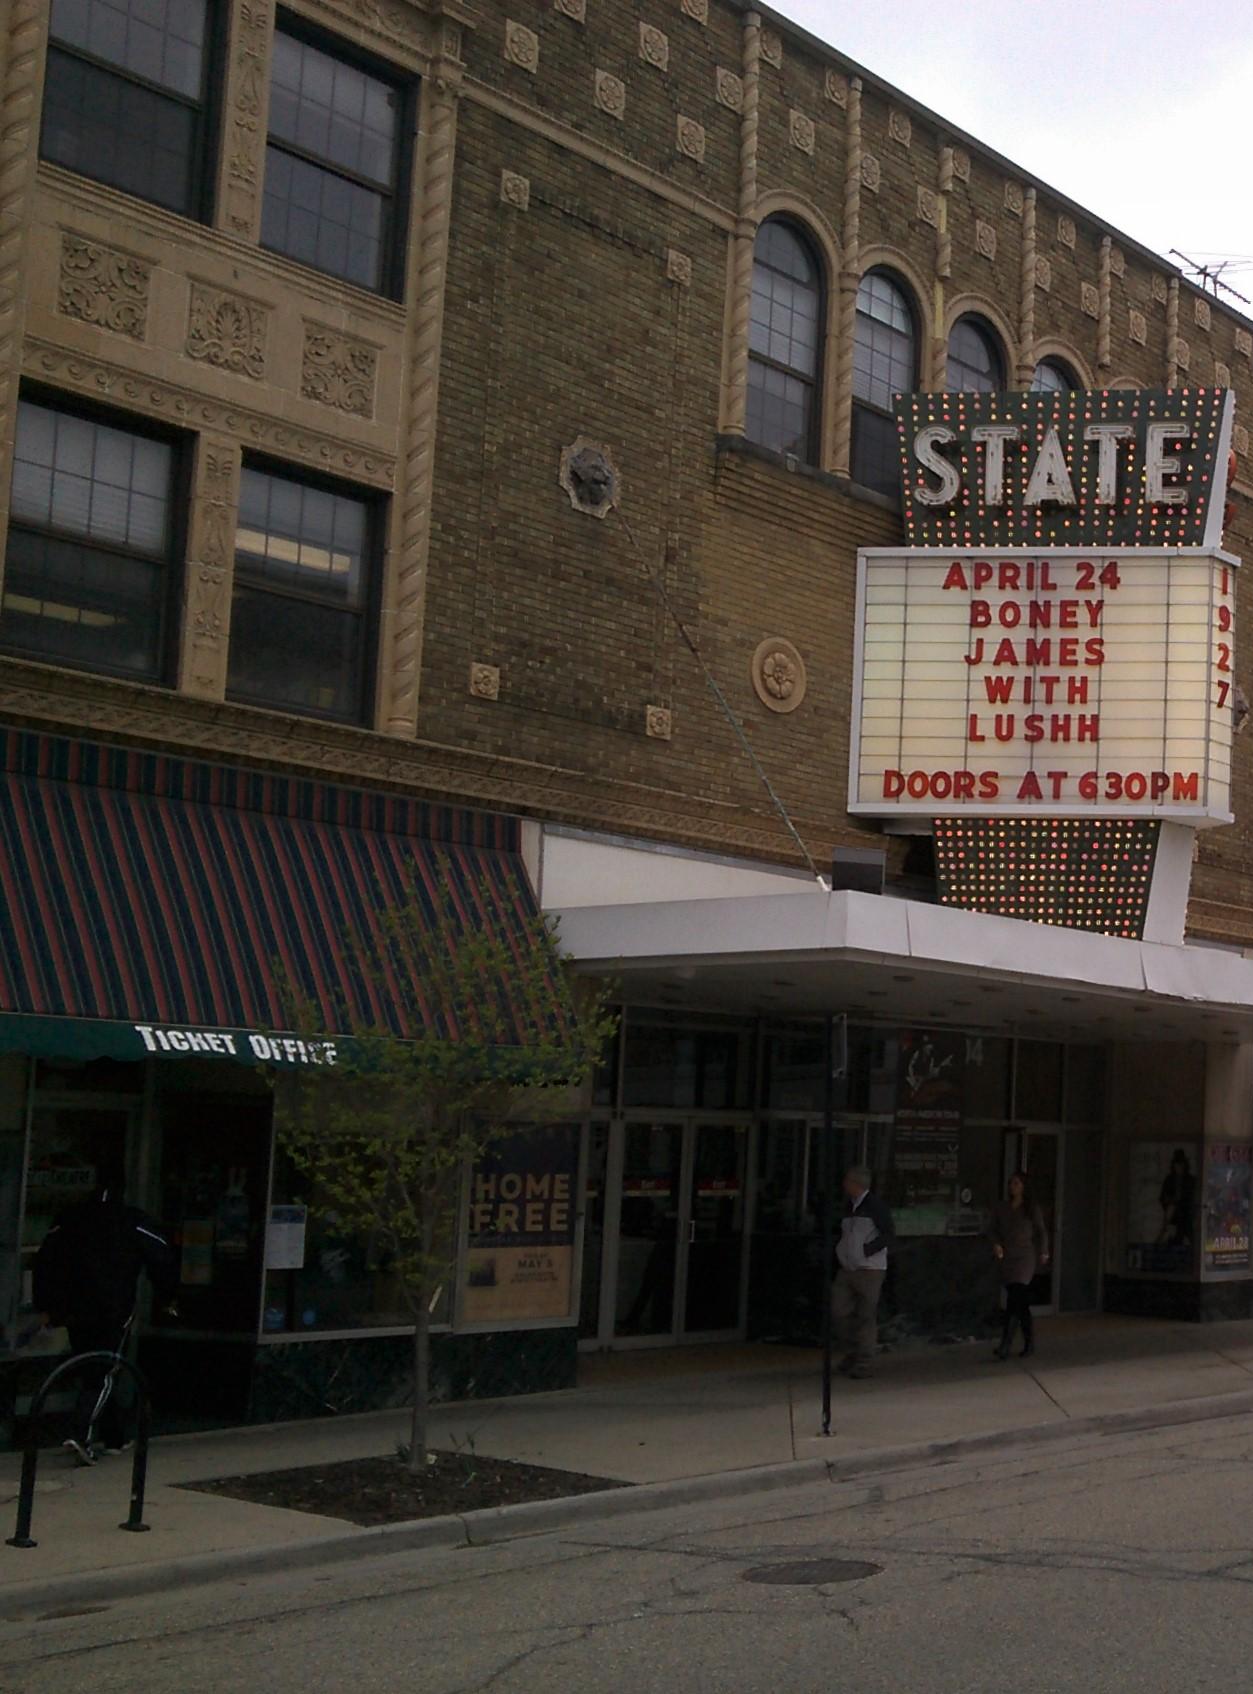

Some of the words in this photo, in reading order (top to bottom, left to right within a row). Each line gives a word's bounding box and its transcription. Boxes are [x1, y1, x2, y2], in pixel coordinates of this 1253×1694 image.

[914, 423, 1191, 506] STATE
[942, 561, 1058, 590] APRIL
[1075, 561, 1121, 590] 24
[970, 600, 1106, 629] BONEY
[964, 637, 1106, 667] JAMES
[984, 676, 1090, 705] WITH
[969, 714, 1100, 742] LUSHH
[883, 769, 1000, 799] DOORS
[1016, 771, 1068, 799] AT
[134, 1024, 237, 1055] TICKET
[474, 1172, 571, 1202] HOME
[471, 1202, 570, 1233] FREE
